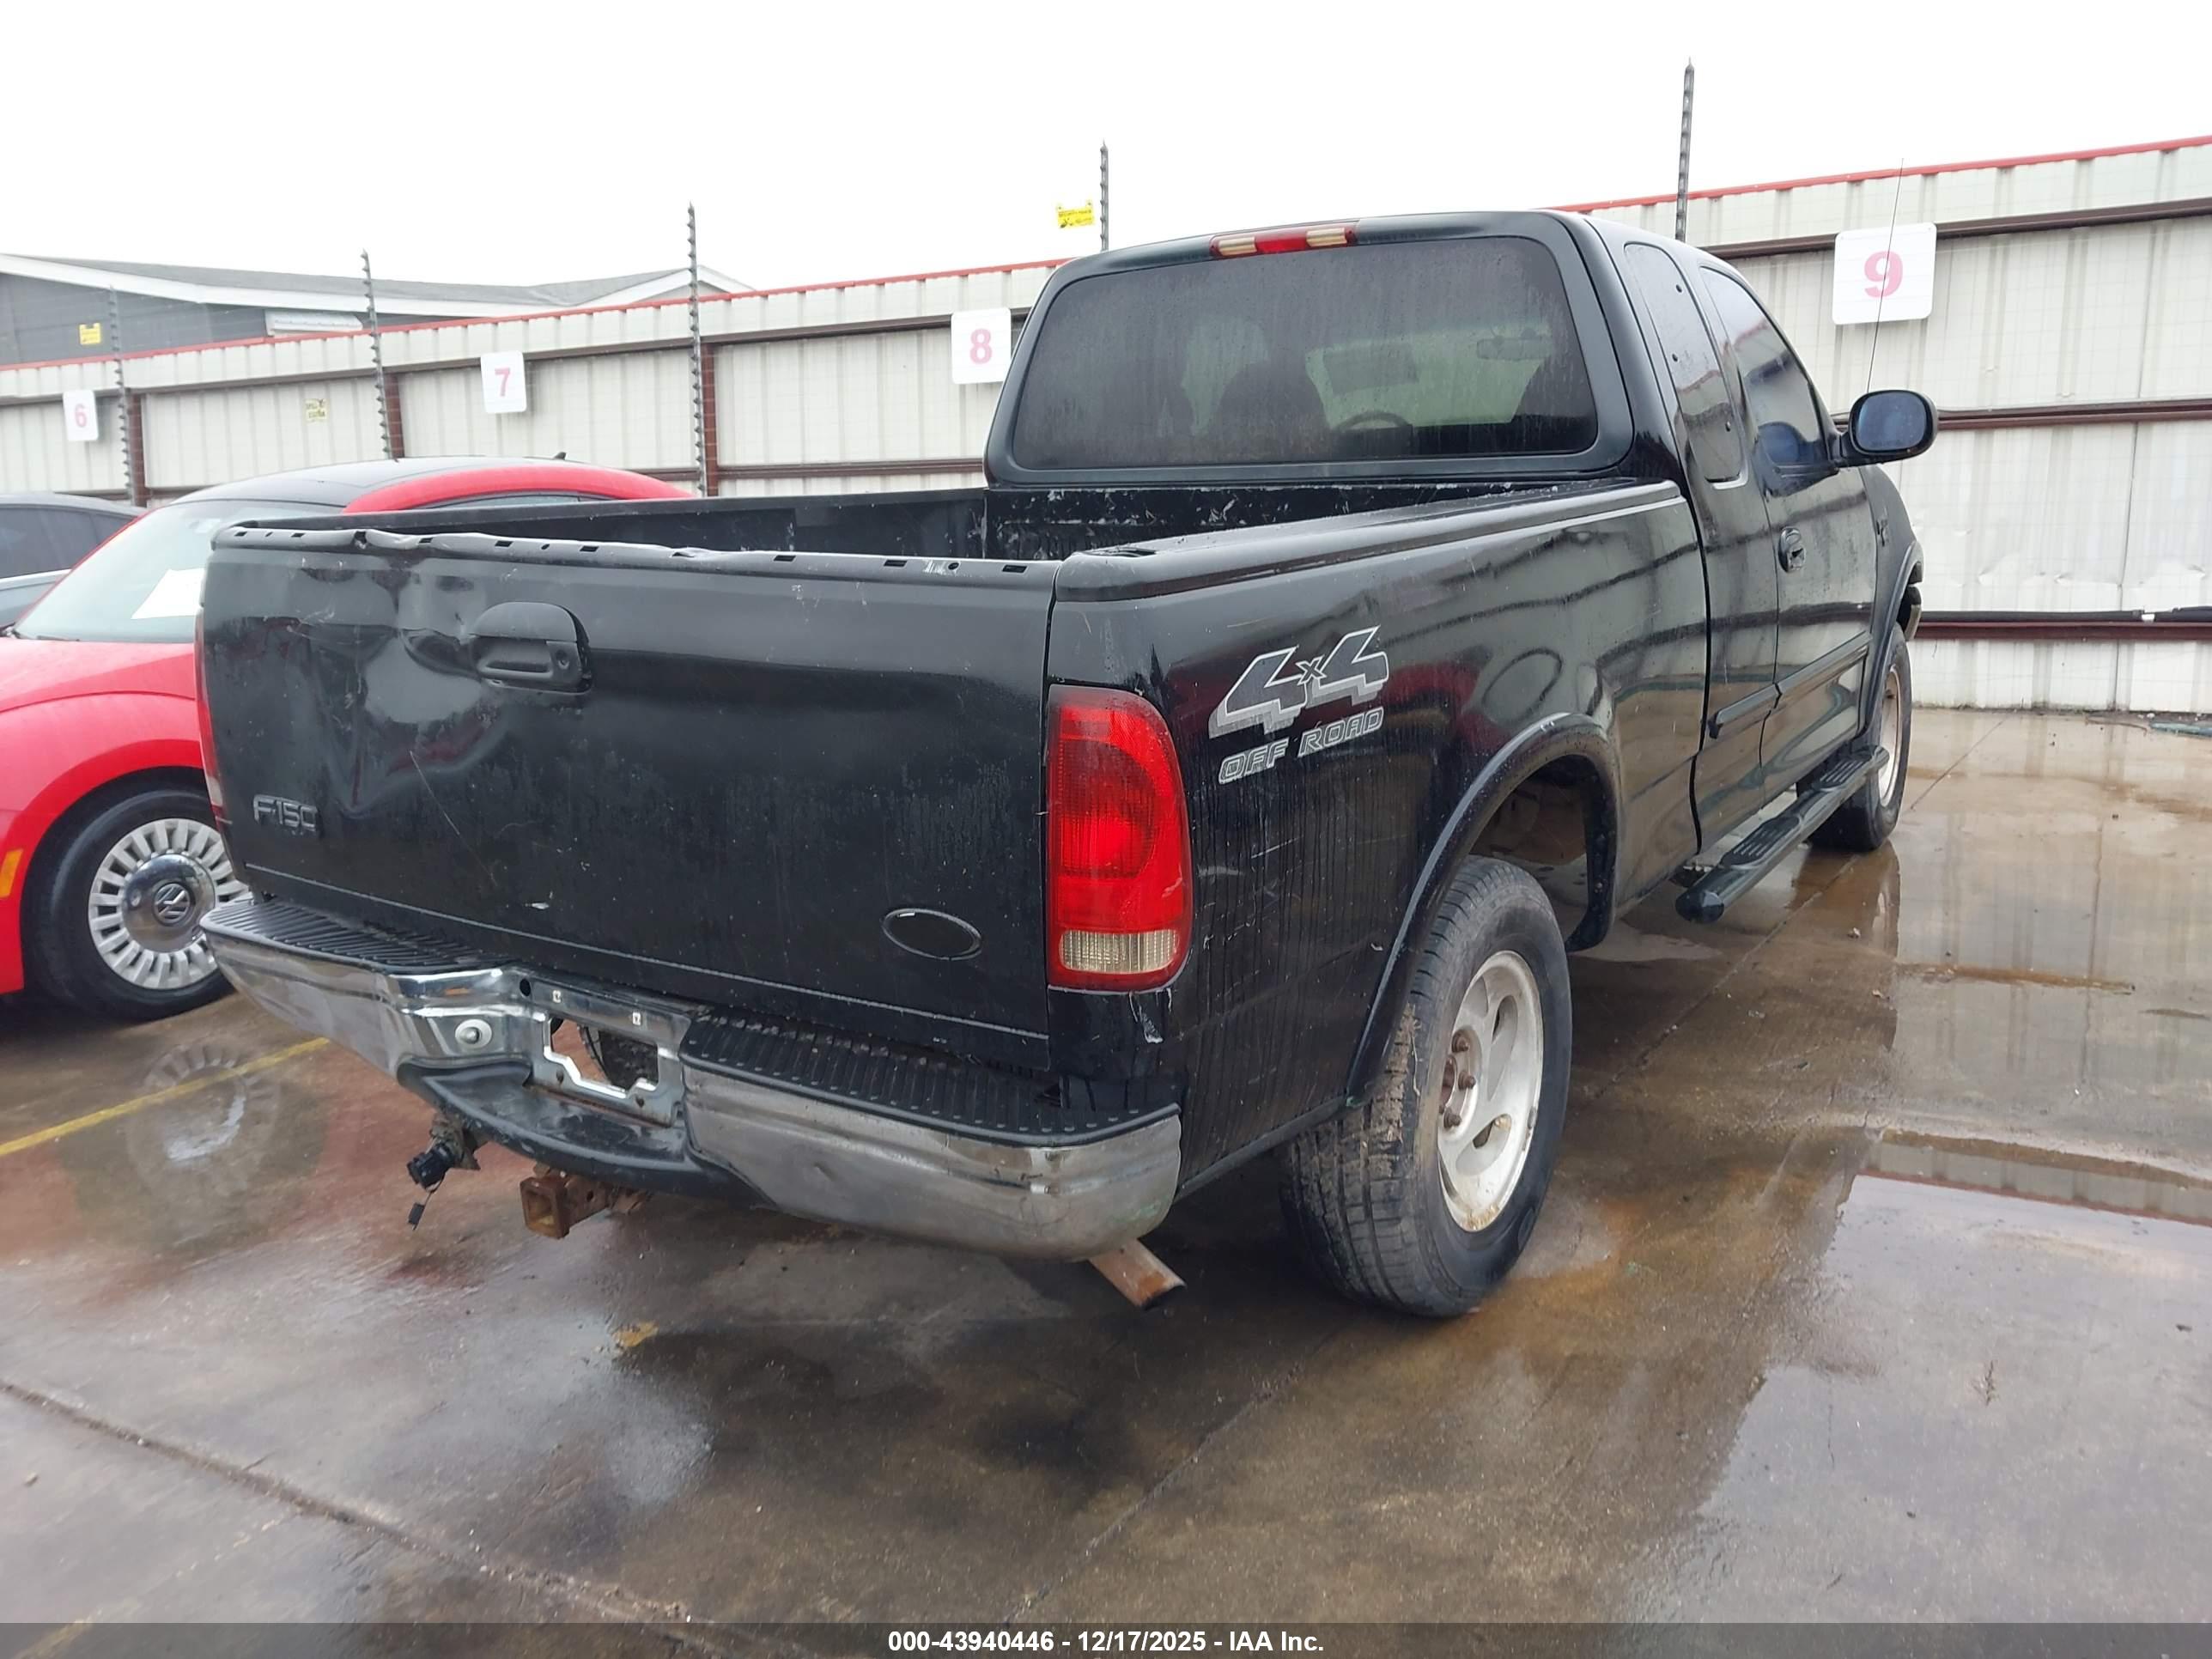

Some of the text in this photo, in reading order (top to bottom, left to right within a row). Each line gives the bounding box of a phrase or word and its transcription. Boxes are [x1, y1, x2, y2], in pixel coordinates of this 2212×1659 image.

[1864, 251, 1904, 298] 9
[969, 328, 993, 364] 8
[494, 367, 511, 397] 7
[75, 403, 87, 428] 6
[1218, 706, 1384, 785] OFF ROAD
